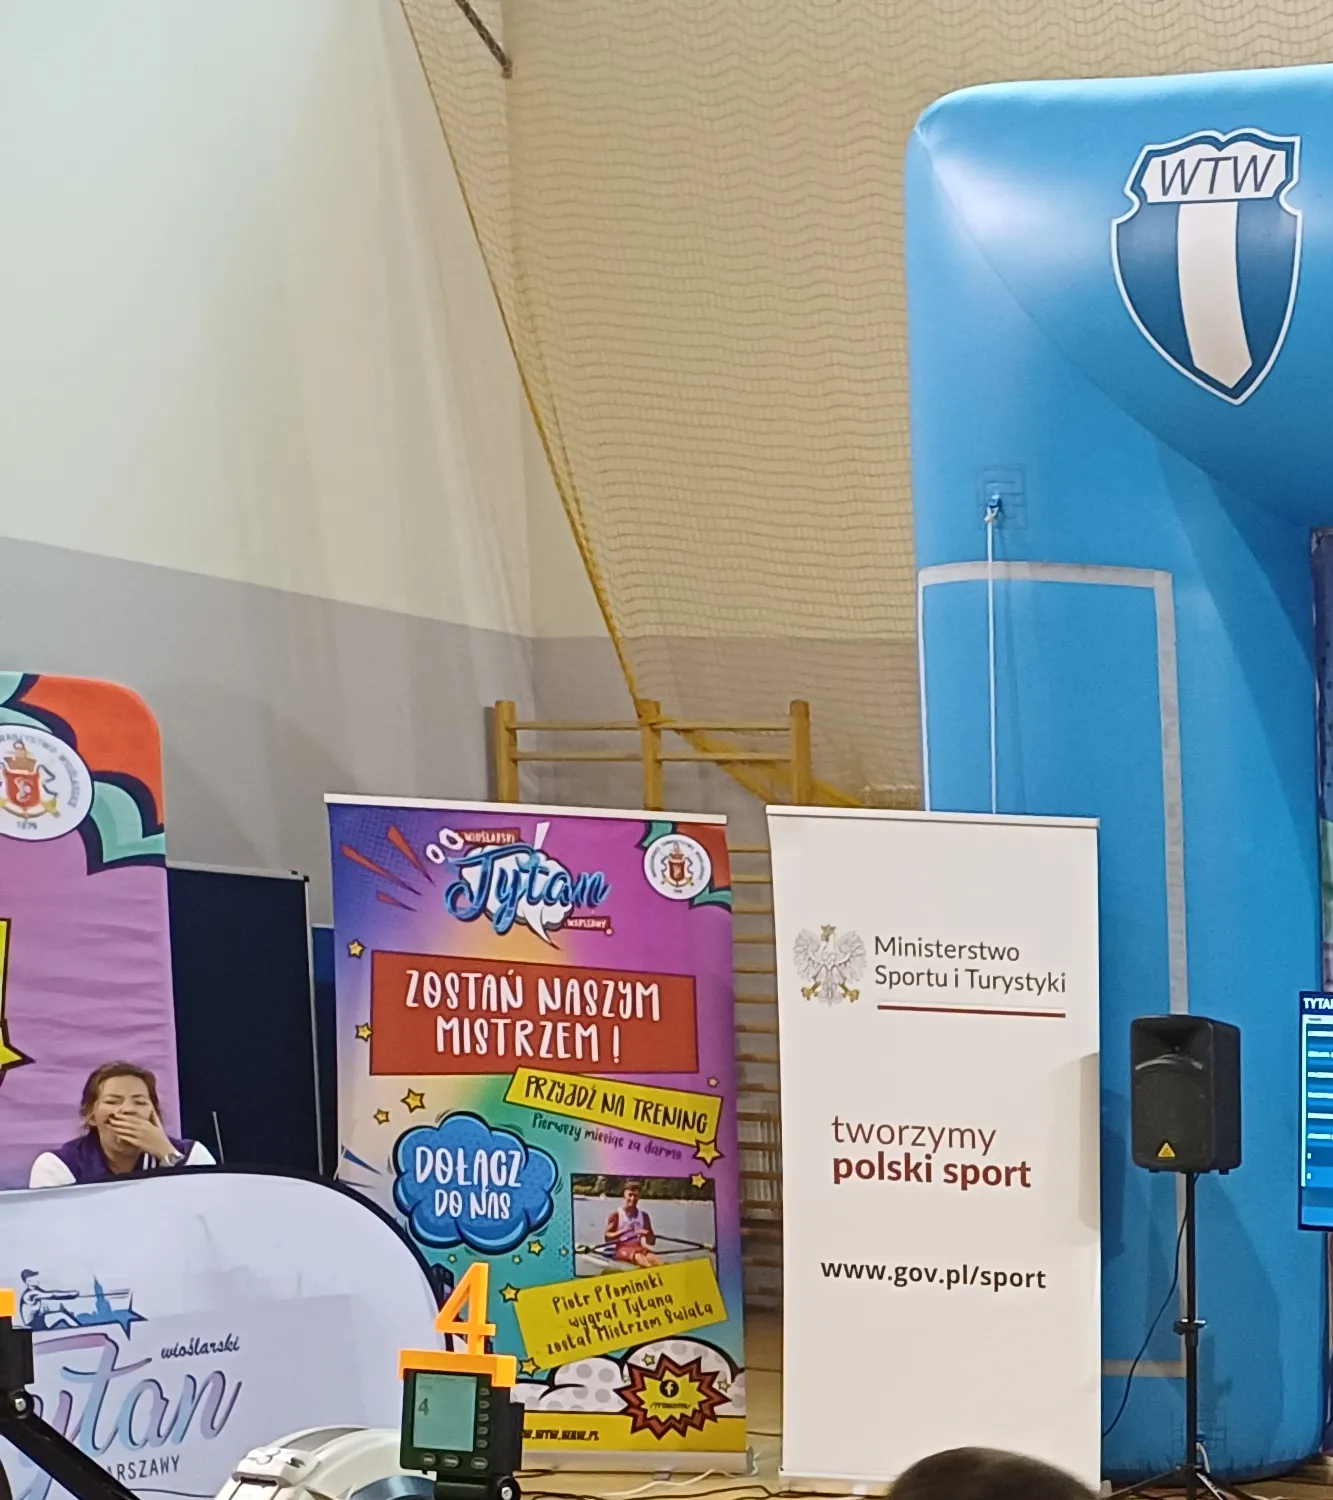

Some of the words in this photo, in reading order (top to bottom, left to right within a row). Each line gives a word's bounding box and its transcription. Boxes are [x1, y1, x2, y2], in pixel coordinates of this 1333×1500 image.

[1156, 152, 1278, 198] WTW
[444, 843, 611, 936] Tytan
[873, 935, 1020, 962] Ministerstwo
[405, 968, 524, 1014] ZOSTAŃ
[537, 977, 660, 1022] NASZYM
[874, 965, 948, 990] Sportu
[953, 967, 960, 989] i
[965, 968, 1067, 996] Turystyki
[435, 1015, 599, 1062] MISTRZEM
[524, 1075, 597, 1110] PRZYJDŹ
[600, 1096, 625, 1118] NA
[633, 1098, 708, 1134] TRENING
[831, 1115, 997, 1156] tworzymy
[415, 1146, 522, 1195] DOŁĄCZ
[832, 1150, 933, 1185] polski
[943, 1160, 1032, 1191] sport
[434, 1188, 463, 1217] DO
[470, 1191, 511, 1219] NAS
[820, 1261, 1047, 1292] www.gov.pl/sport
[434, 1262, 497, 1355] 4
[552, 1291, 591, 1314] Piotr
[624, 1293, 674, 1319] Tytana
[160, 1333, 241, 1360] wioślarski
[418, 1397, 430, 1416] 4
[107, 1454, 181, 1482] RSZAWY
